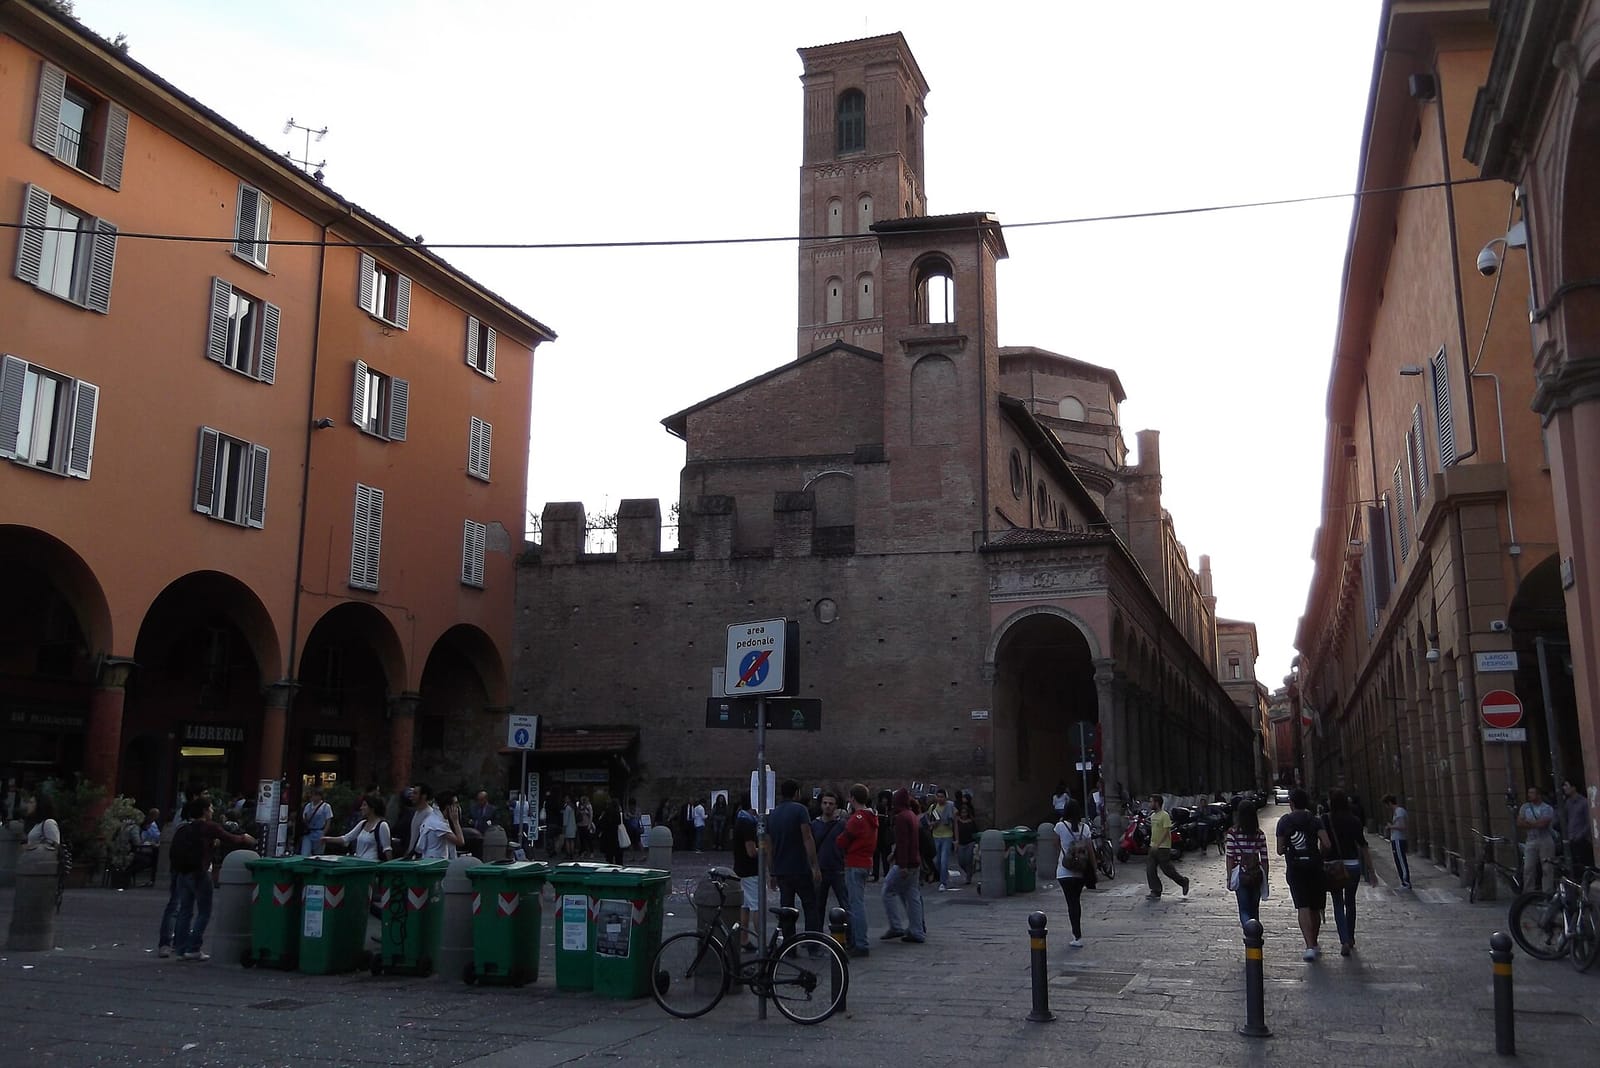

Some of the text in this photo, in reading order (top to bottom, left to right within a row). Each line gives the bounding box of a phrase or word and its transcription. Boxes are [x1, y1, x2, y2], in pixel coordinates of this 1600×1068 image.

[747, 626, 765, 635] area
[736, 636, 775, 649] pedonale
[185, 724, 244, 742] LIBRERIA
